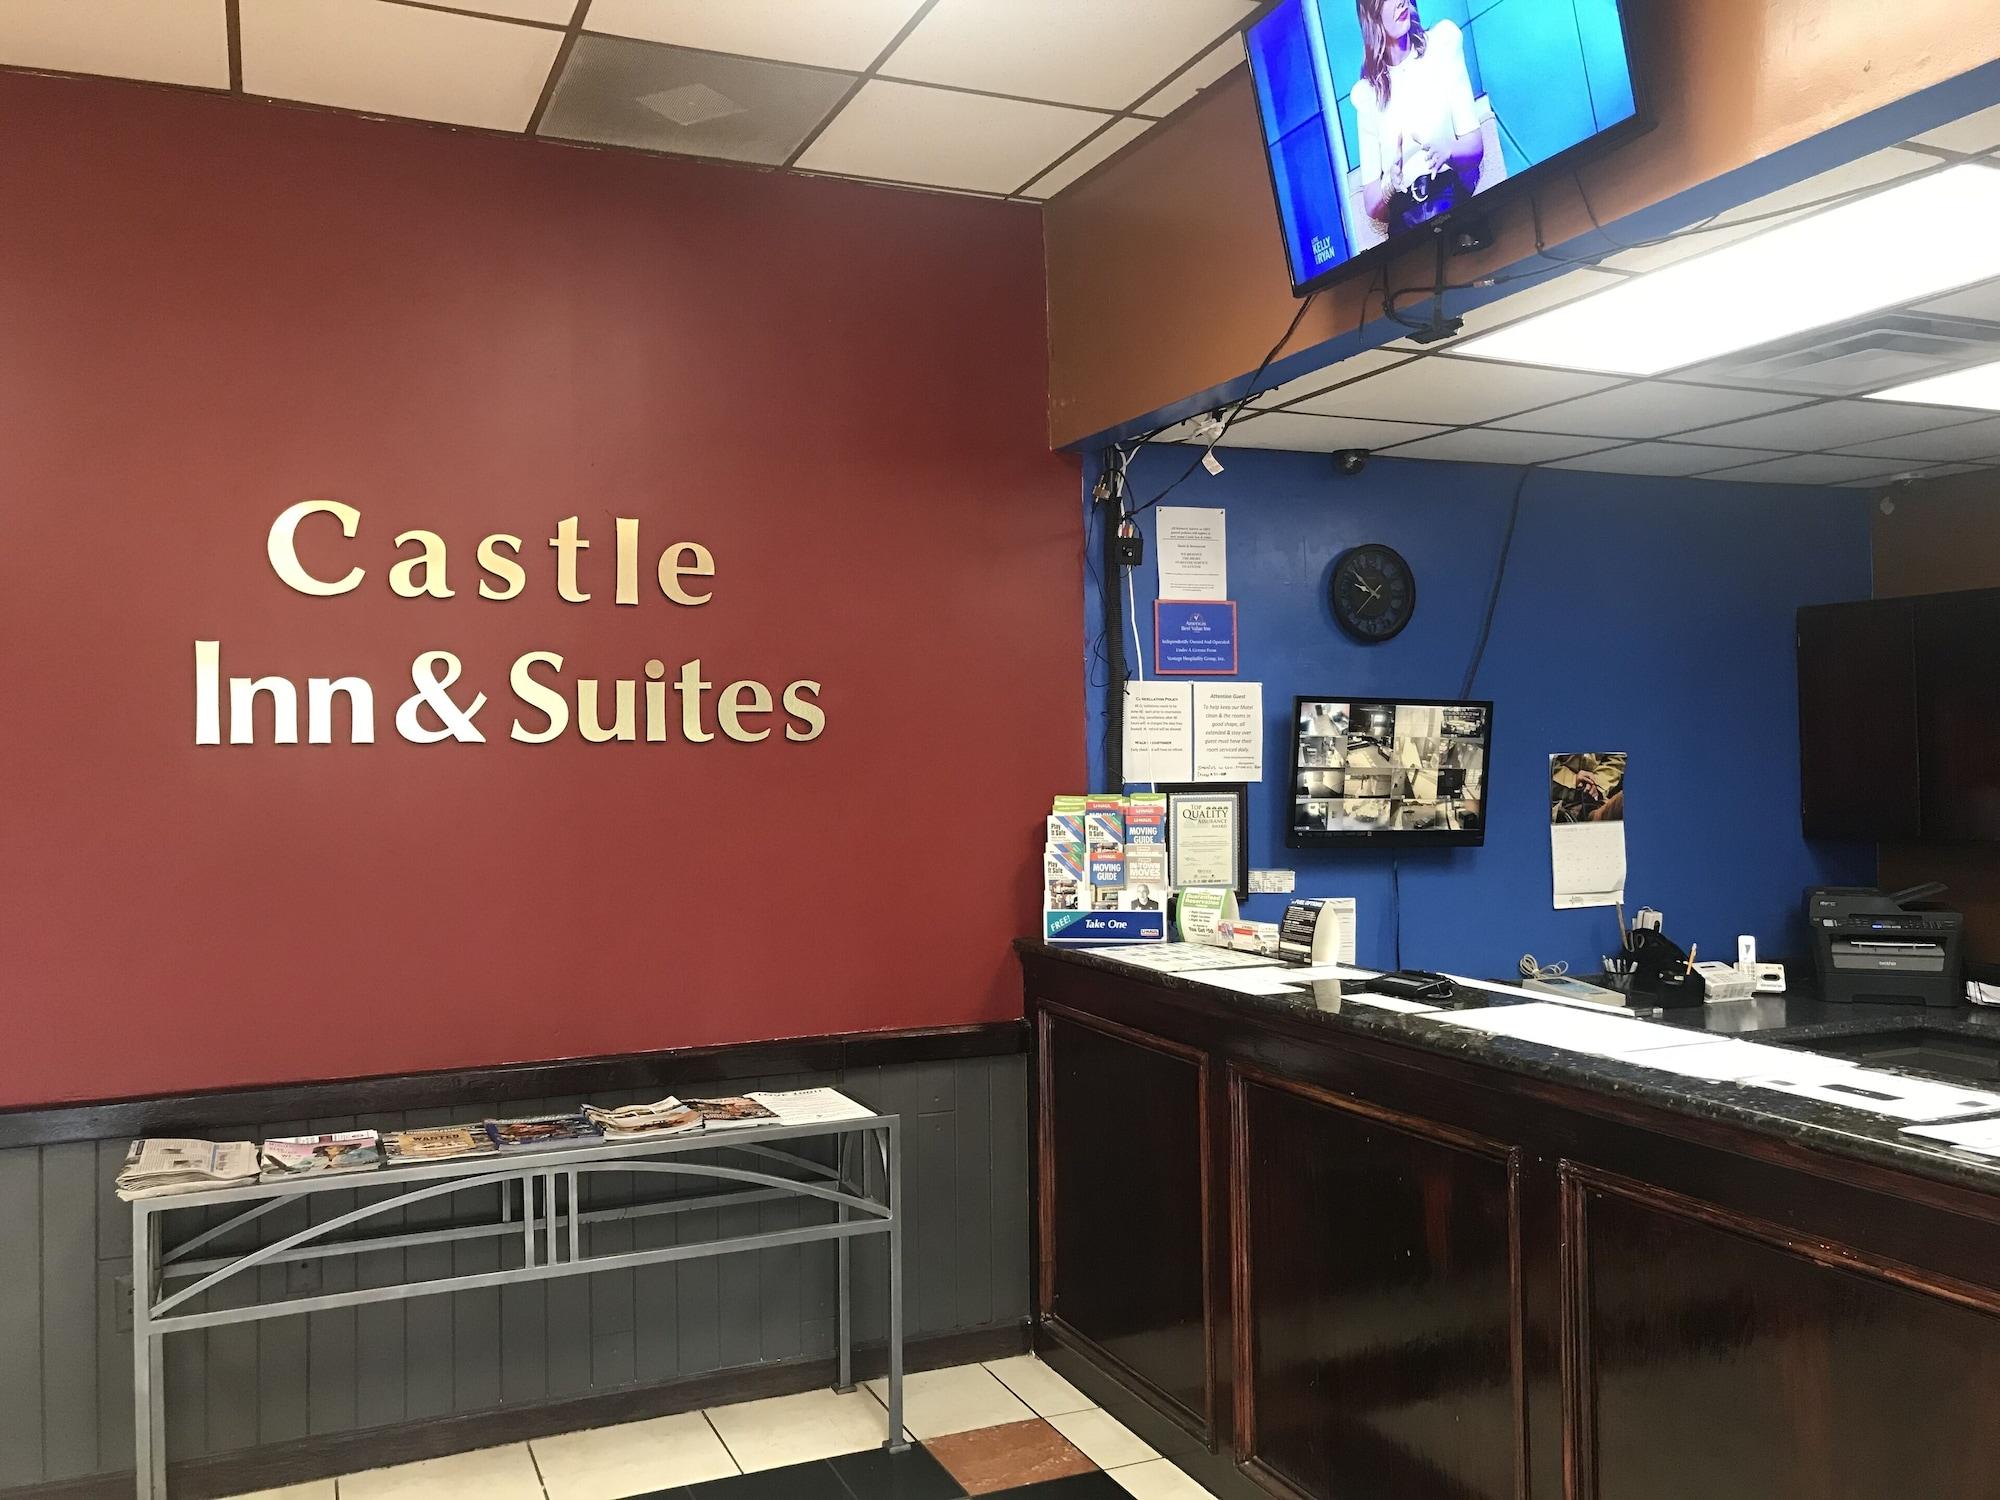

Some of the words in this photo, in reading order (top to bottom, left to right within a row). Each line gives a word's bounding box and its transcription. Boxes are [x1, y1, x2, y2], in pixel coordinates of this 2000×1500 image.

[1312, 236, 1331, 255] KELLY
[1317, 246, 1335, 265] RYAN
[267, 499, 716, 606] Castle
[194, 640, 375, 745] Inn
[395, 650, 488, 744] &
[509, 650, 826, 744] Suites
[1182, 808, 1228, 821] QUALITY
[1050, 823, 1061, 831] Play
[1088, 824, 1099, 832] Play
[1129, 826, 1158, 837] MOVING
[1133, 835, 1154, 843] GUIDE
[1047, 860, 1058, 869] Play
[1092, 863, 1121, 872] MOVING
[1097, 872, 1118, 881] GUIDE
[1129, 868, 1161, 876] MOVES
[1050, 914, 1072, 932] FREE!
[1085, 919, 1106, 929] Take
[1107, 919, 1128, 929] One
